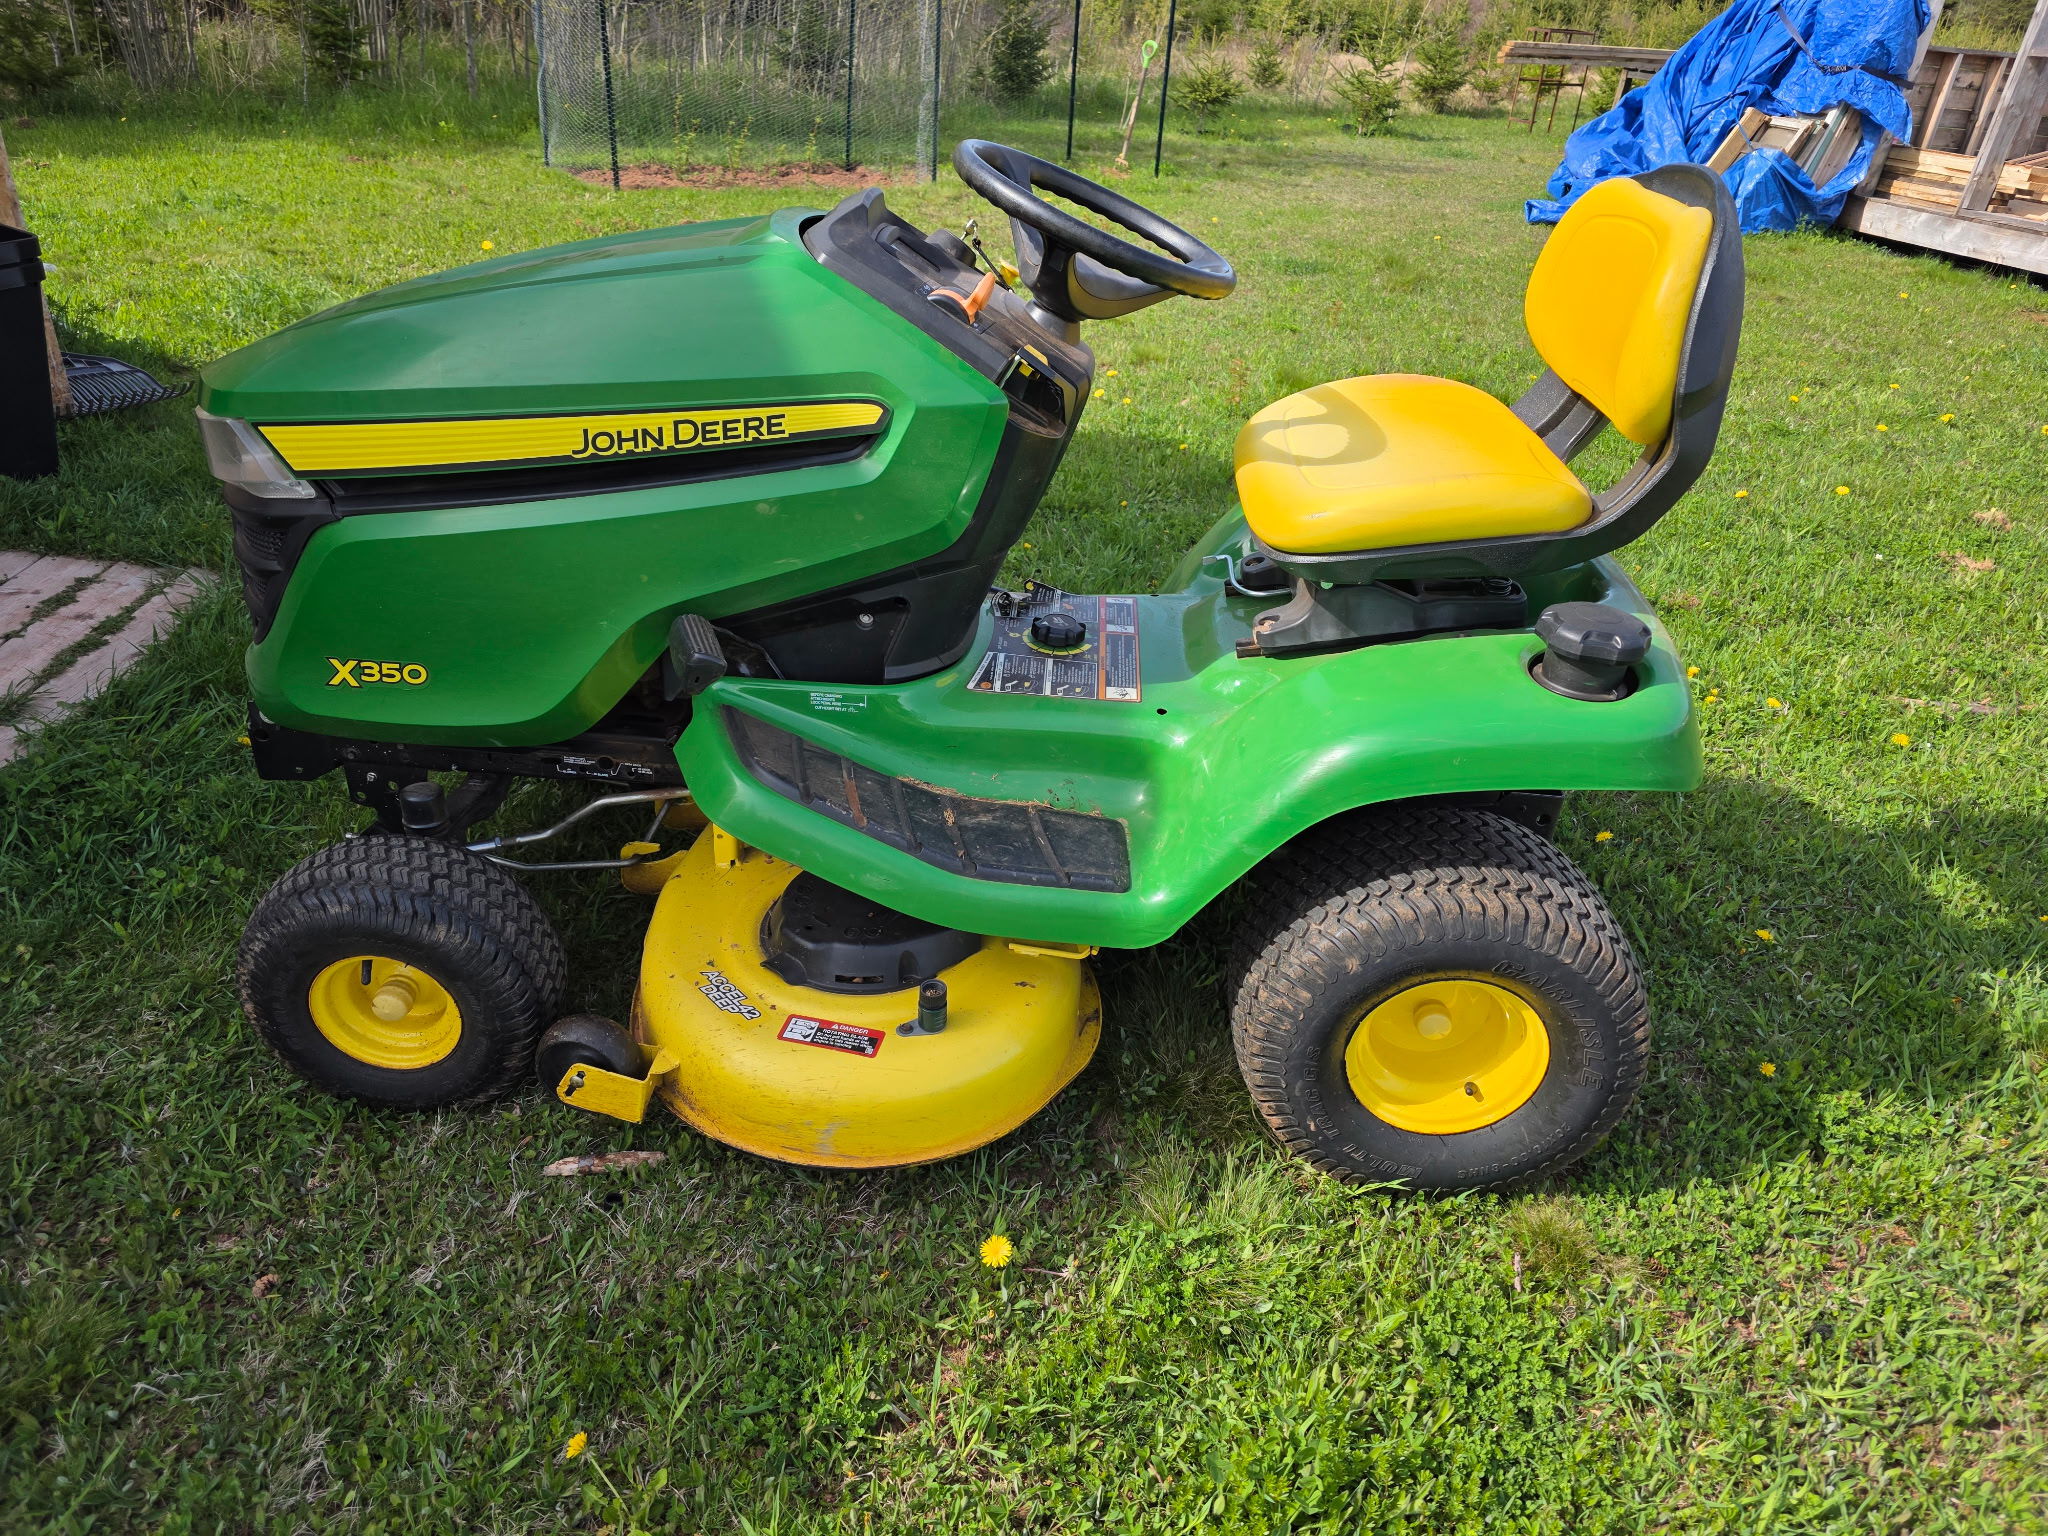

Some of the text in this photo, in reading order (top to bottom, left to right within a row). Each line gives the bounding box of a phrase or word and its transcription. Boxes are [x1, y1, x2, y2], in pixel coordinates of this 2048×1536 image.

[572, 413, 786, 455] JOHN DEERE
[325, 657, 429, 688] X350
[698, 984, 741, 1013] DEEP
[699, 971, 748, 1008] ACCEL
[840, 1024, 869, 1035] DANGER
[1492, 960, 1605, 1090] CARLISLE
